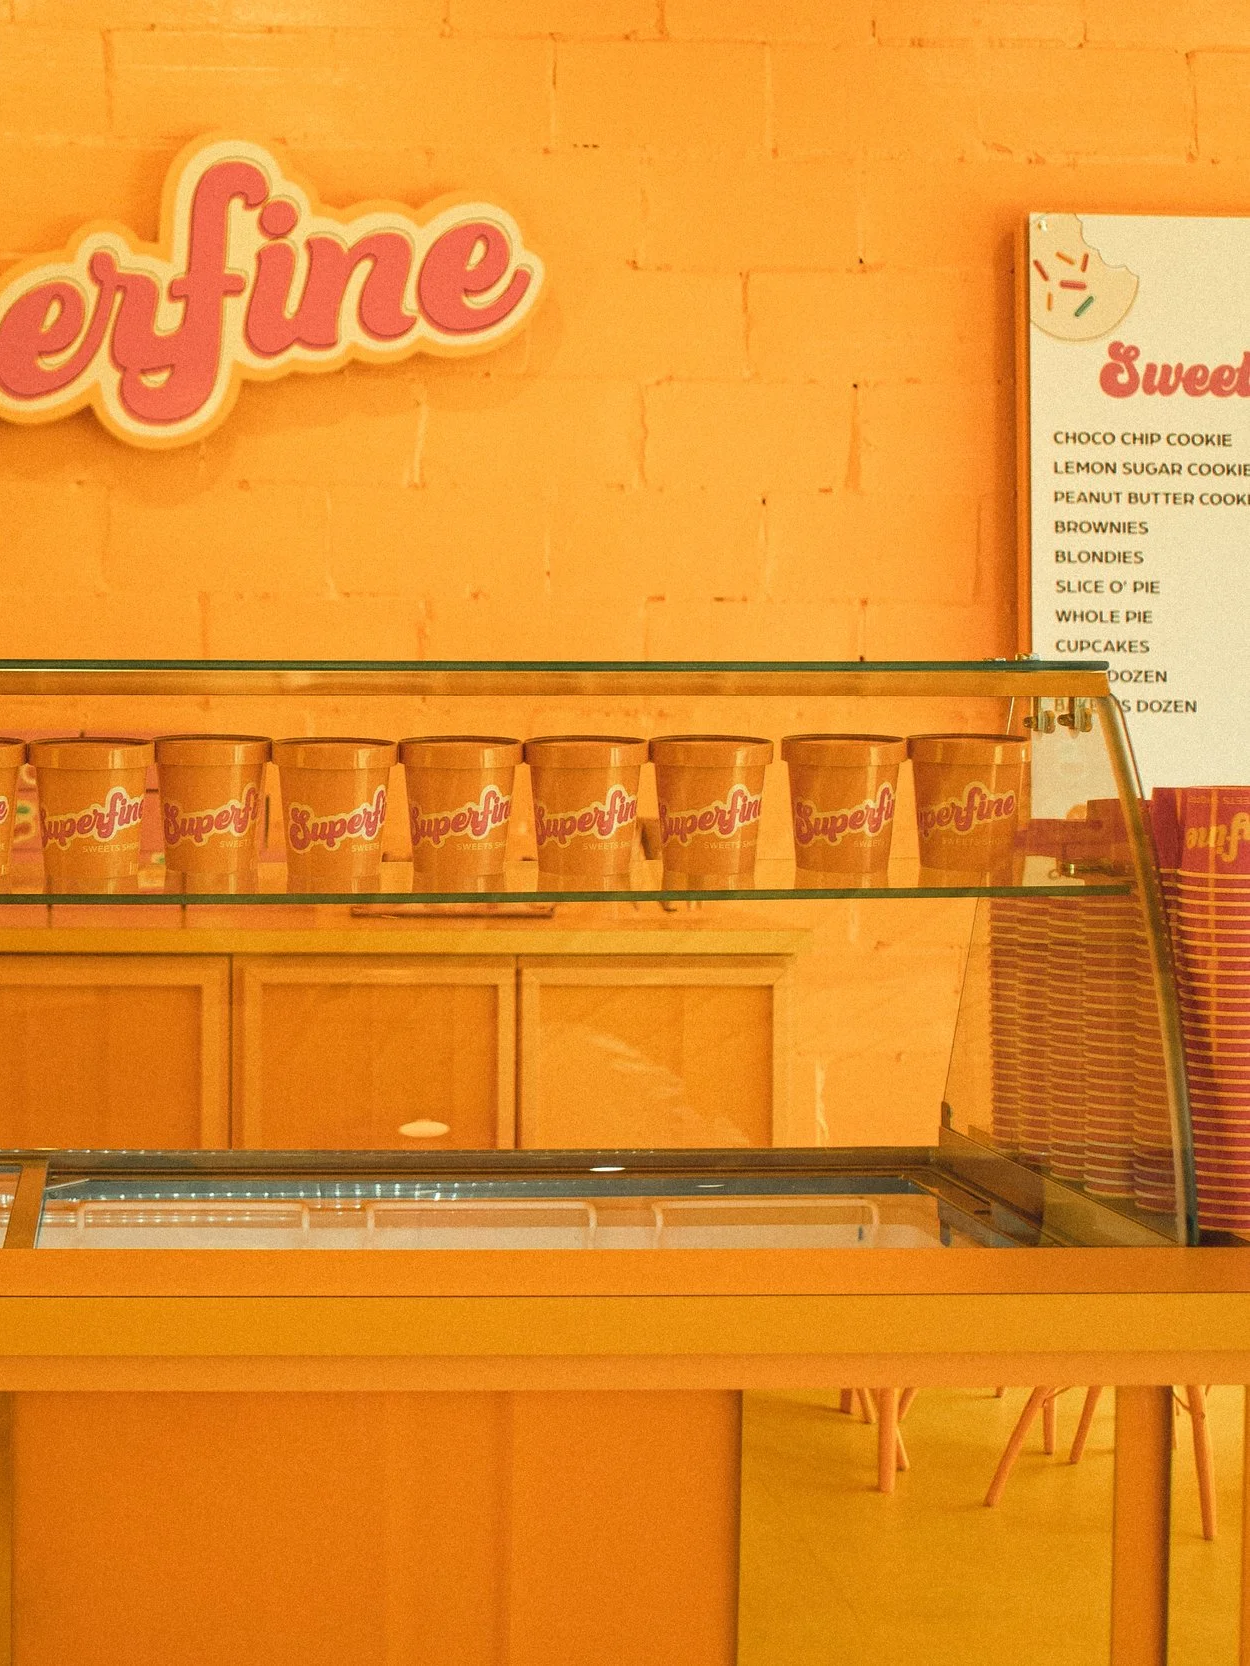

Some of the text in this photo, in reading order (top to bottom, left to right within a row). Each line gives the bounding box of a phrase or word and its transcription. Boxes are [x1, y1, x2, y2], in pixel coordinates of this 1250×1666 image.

[1053, 431, 1233, 447] CHOCO CHIP COOKIE
[1053, 461, 1117, 475] LEMON
[1122, 462, 1183, 475] SUGAR
[1053, 491, 1123, 504] PEANUT
[1127, 492, 1195, 506] BUTTER
[1054, 520, 1149, 535] BROWNIES
[1054, 550, 1144, 564] BLONDIES
[1055, 580, 1105, 594] SLICE
[1132, 580, 1161, 594] PIE
[1055, 610, 1153, 624] WHOLE PIE
[1055, 639, 1150, 653] CUPCAKES
[1107, 670, 1168, 683] DOZEN
[1137, 700, 1197, 713] DOZEN
[81, 844, 120, 853] SWEETS
[456, 842, 493, 851] SWEETS
